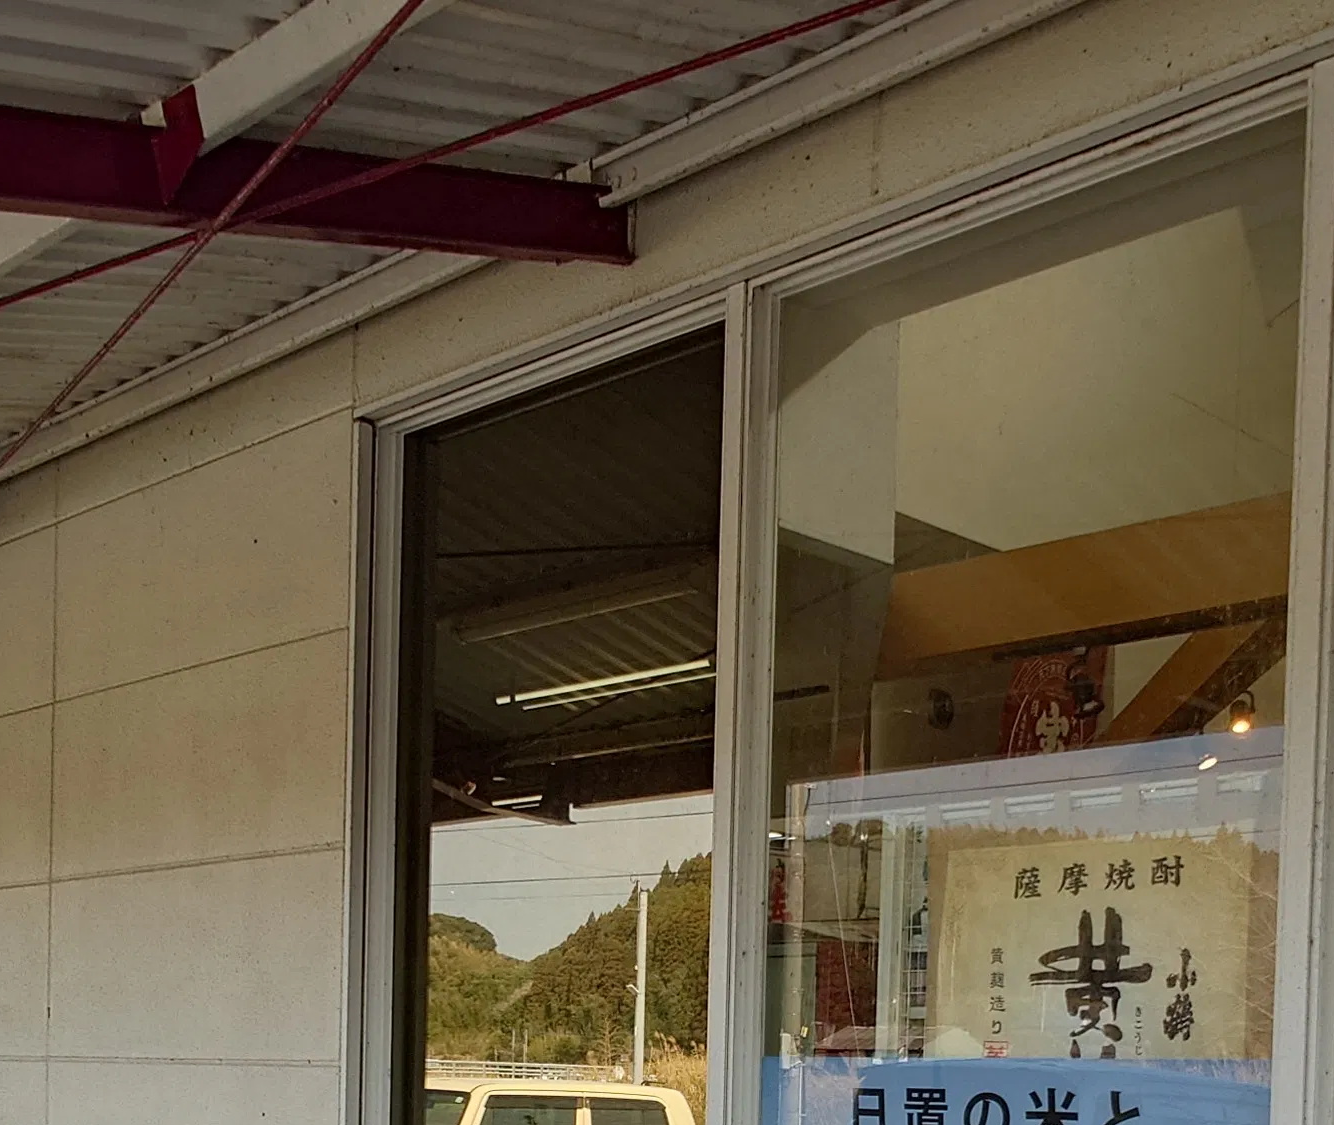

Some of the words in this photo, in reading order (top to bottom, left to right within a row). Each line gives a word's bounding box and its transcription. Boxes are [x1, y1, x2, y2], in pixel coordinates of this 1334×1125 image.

[1014, 855, 1185, 900] 薩摩焼酎
[1028, 906, 1154, 1058] 黄
